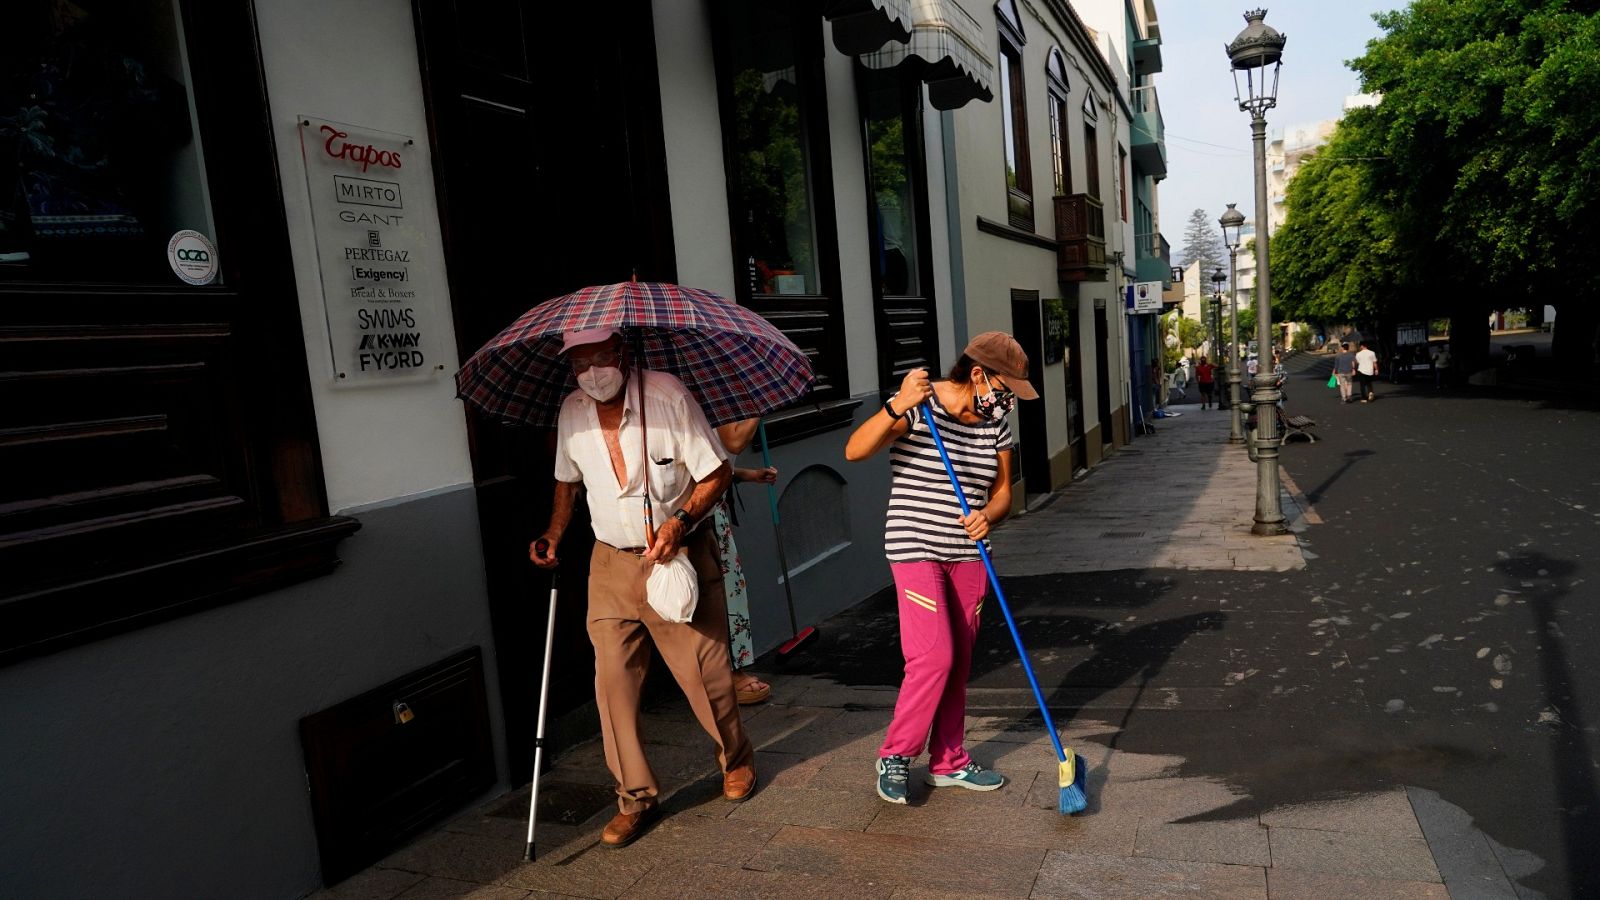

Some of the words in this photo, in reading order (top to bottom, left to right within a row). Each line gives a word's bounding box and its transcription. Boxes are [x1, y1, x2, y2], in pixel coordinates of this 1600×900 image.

[320, 125, 401, 172] Trapos
[341, 183, 396, 201] MIRTO
[339, 210, 404, 226] GANT
[344, 247, 410, 262] PERTEGAZ
[350, 287, 375, 298] Bread
[377, 287, 387, 298] &
[388, 287, 416, 299] Boxers
[359, 351, 424, 371] FYORD
